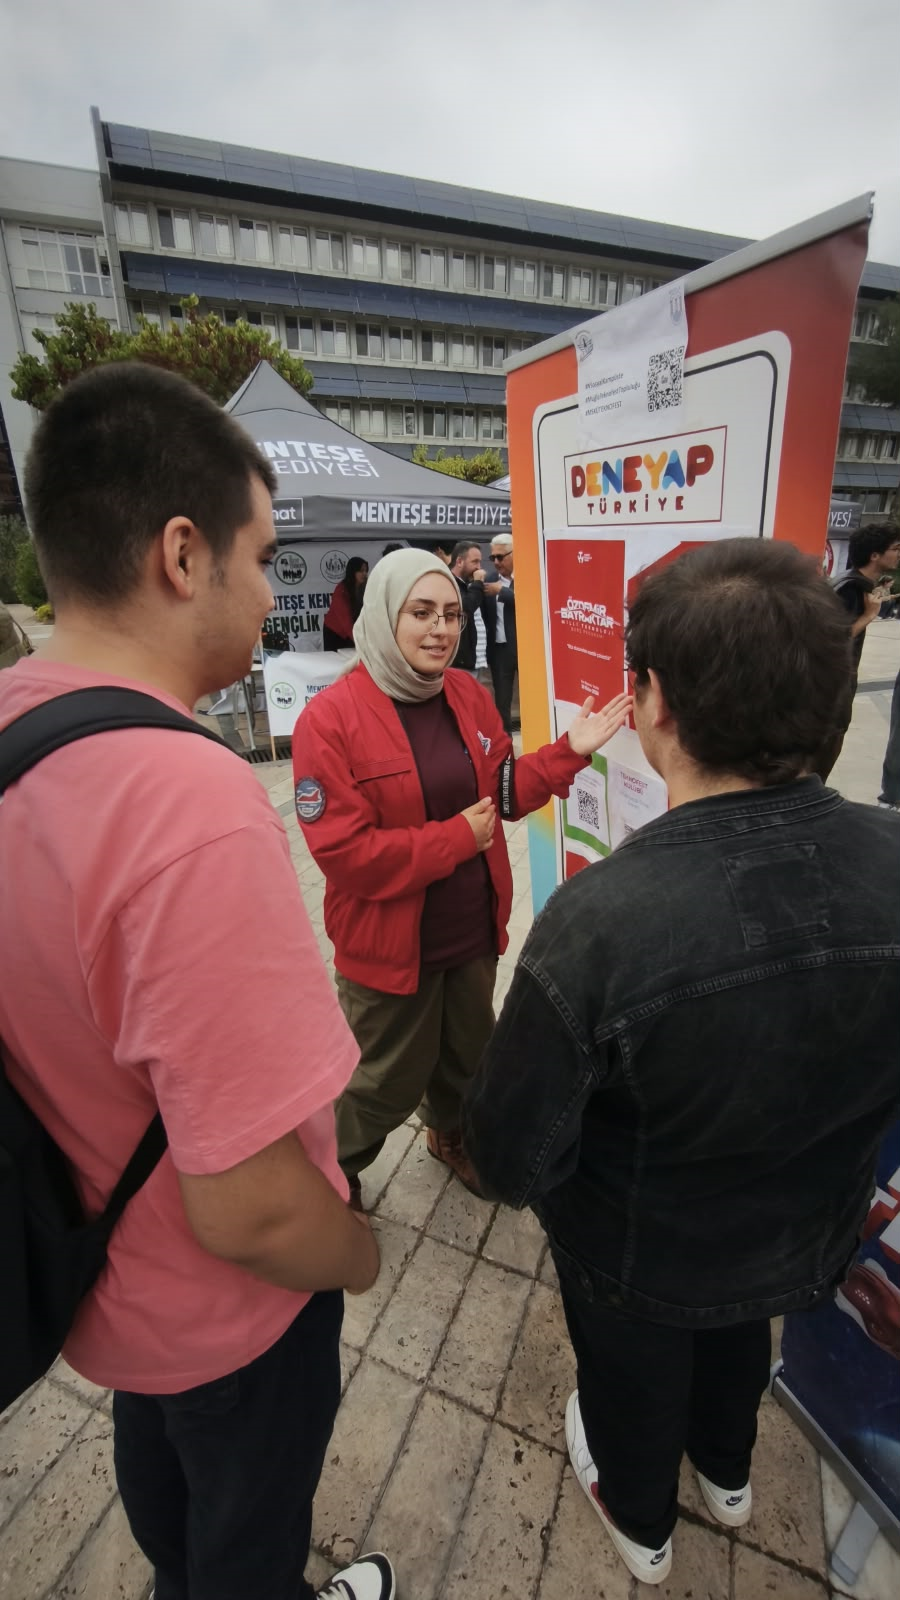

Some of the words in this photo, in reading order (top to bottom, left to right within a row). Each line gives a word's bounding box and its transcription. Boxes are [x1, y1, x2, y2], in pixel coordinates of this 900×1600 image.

[256, 440, 370, 463] NTEŞE
[272, 459, 380, 478] EDİYESİ
[571, 444, 714, 498] DENEYAP
[272, 506, 296, 520] nat
[351, 501, 430, 526] MENTEŞE
[436, 503, 512, 526] BELEDİYES
[587, 494, 684, 515] TÜRKİYE
[829, 508, 853, 527] YESİ
[273, 594, 305, 614] TEŞE
[263, 611, 320, 638] GENÇLİK
